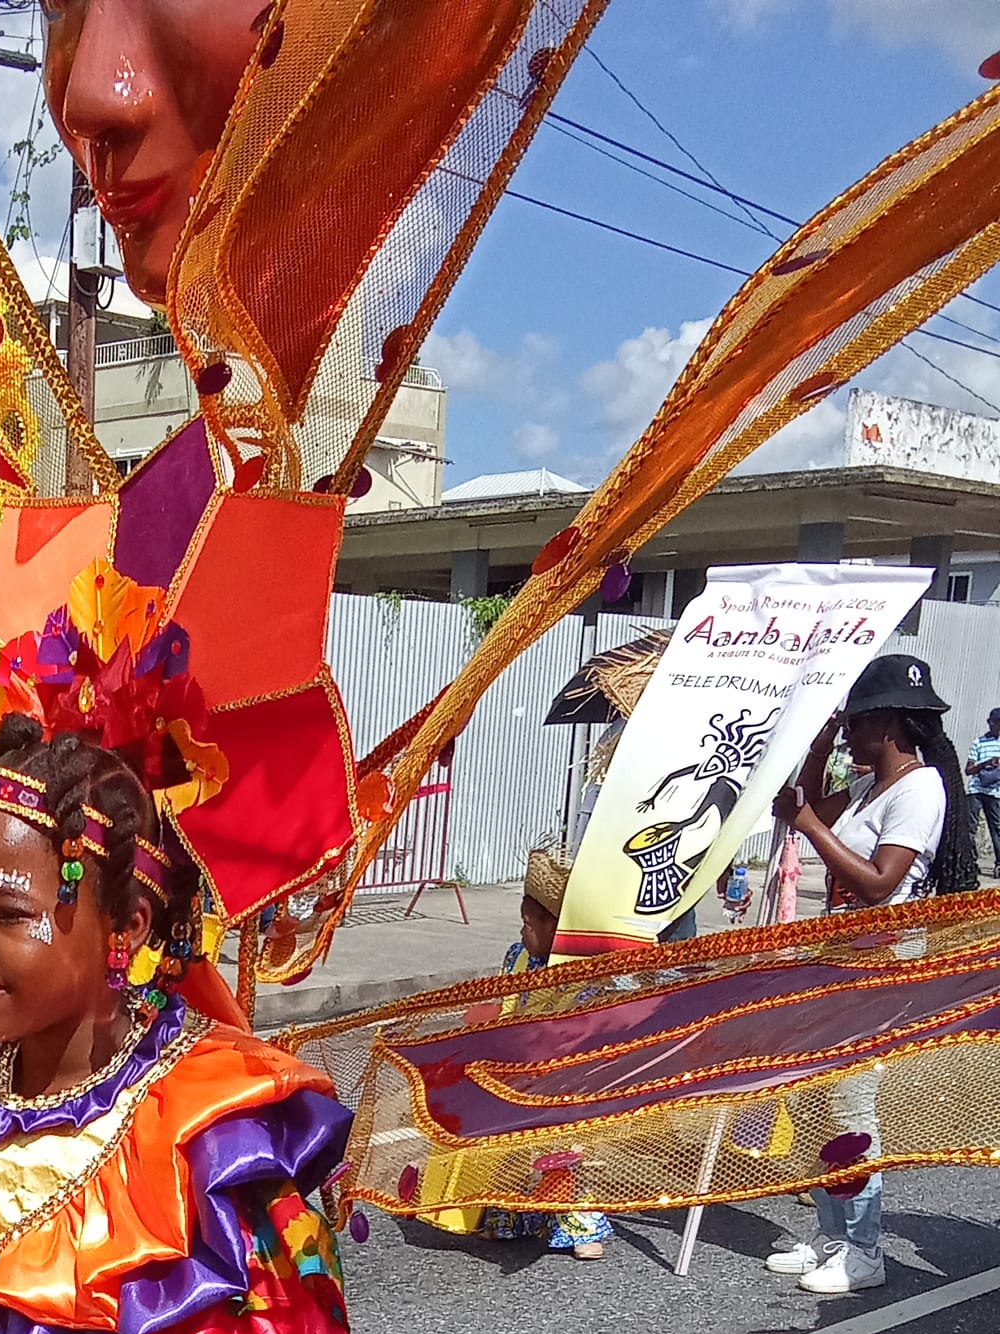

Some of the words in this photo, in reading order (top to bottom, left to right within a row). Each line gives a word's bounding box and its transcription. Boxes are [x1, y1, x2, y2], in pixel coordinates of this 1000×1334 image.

[760, 595, 811, 612] Rotten
[845, 598, 887, 611] 2026
[716, 649, 751, 659] TRIBUTE
[752, 650, 765, 658] TO
